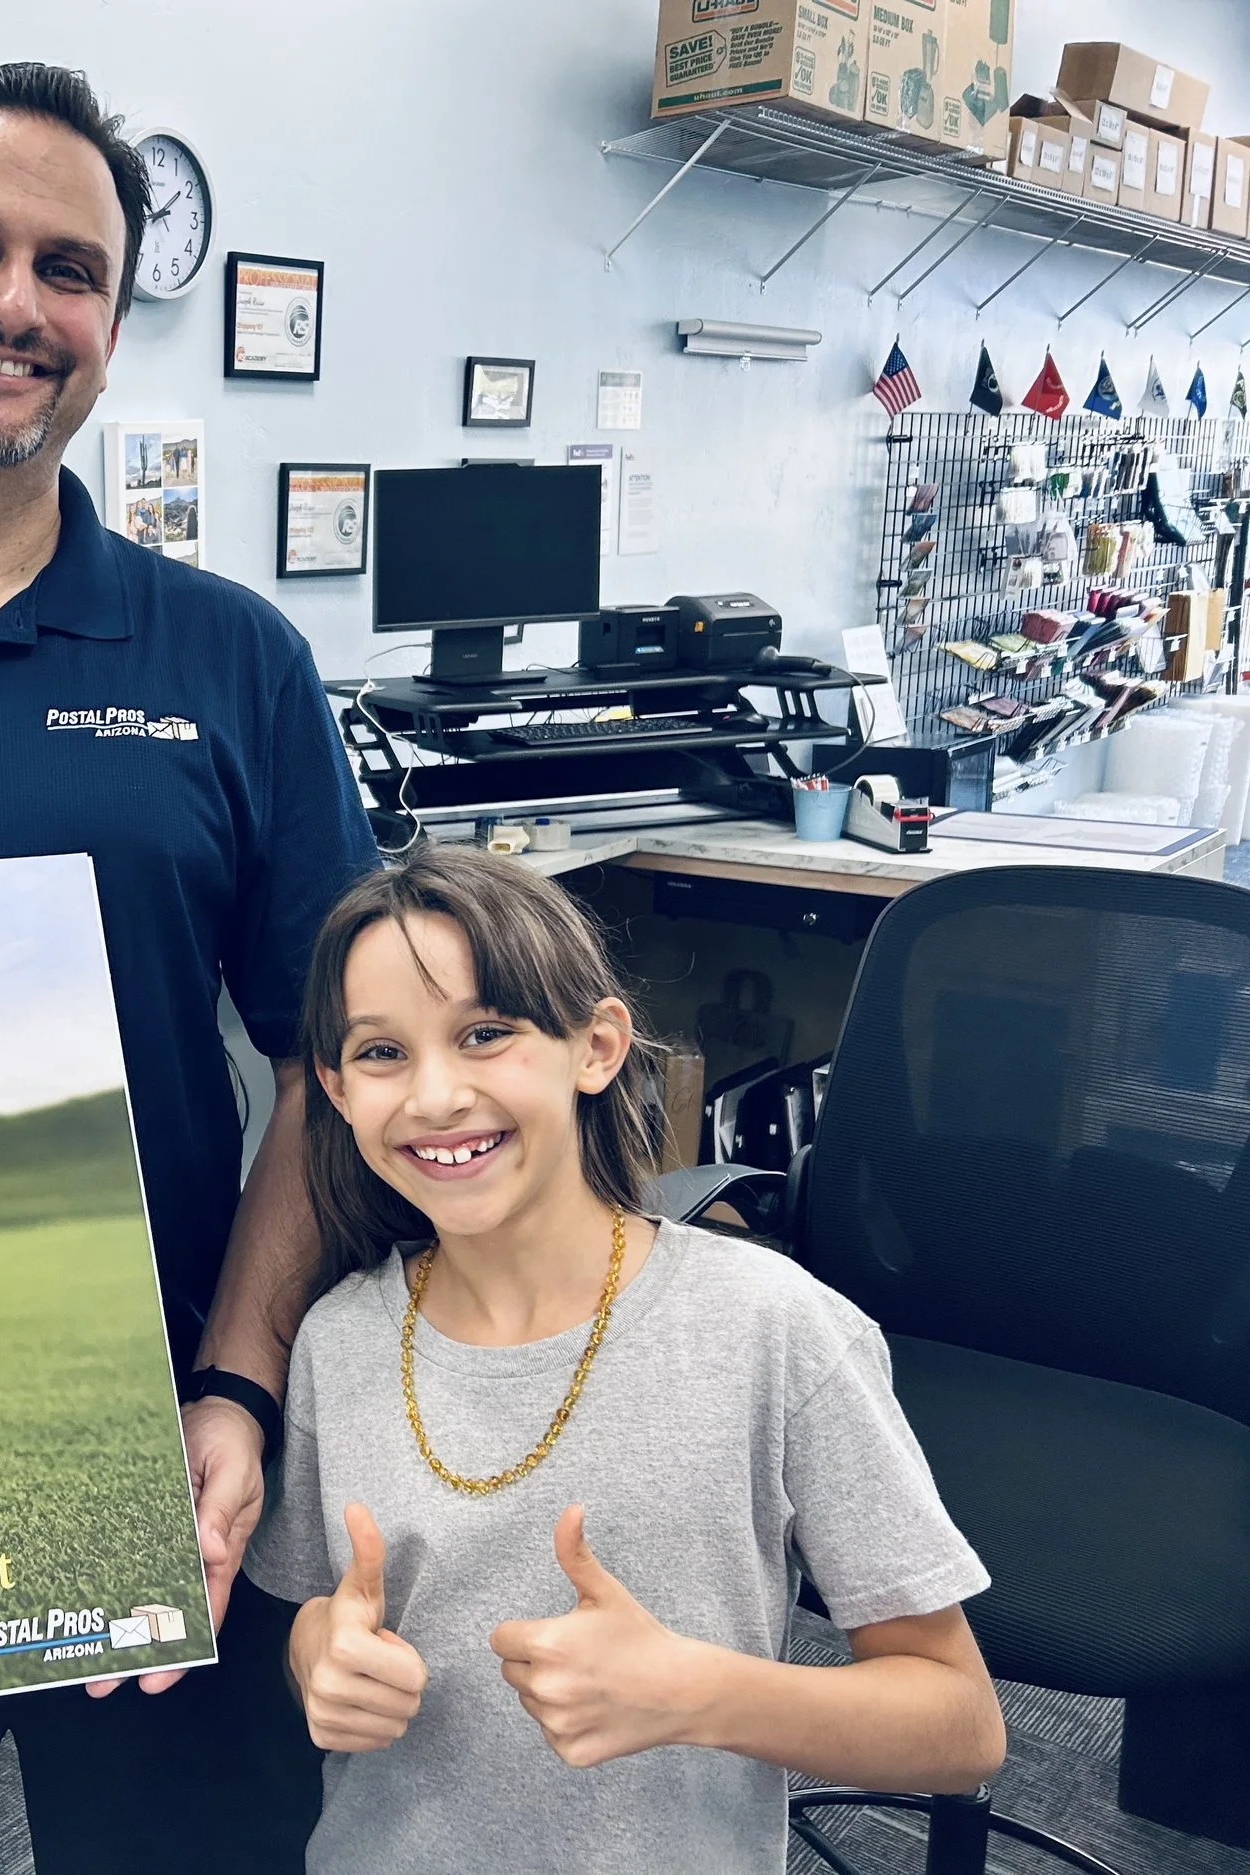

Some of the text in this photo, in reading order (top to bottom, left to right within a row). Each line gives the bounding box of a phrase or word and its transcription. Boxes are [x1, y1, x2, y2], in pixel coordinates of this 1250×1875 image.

[798, 5, 828, 29] SMALL BOX
[873, 5, 899, 28] MEDIUM
[901, 16, 913, 34] BOX
[669, 35, 713, 59] SAVE!
[670, 53, 713, 73] BEST PRICE
[670, 63, 714, 82] GUARANTEED
[801, 68, 812, 84] OK
[693, 87, 743, 101] uhaul.com
[876, 91, 888, 105] OK
[949, 114, 959, 128] OK
[152, 146, 165, 168] 12
[174, 158, 178, 177] 1
[185, 180, 193, 199] 2
[190, 211, 199, 230] 3
[184, 238, 193, 256] 4
[152, 263, 161, 282] 6
[171, 258, 180, 276] 5
[238, 268, 317, 289] PROFESSIONAL
[46, 706, 146, 726] POSTAL PROS
[95, 727, 146, 738] ARIZONA
[46, 1607, 106, 1640] PROS
[42, 1641, 104, 1663] ARIZONA
